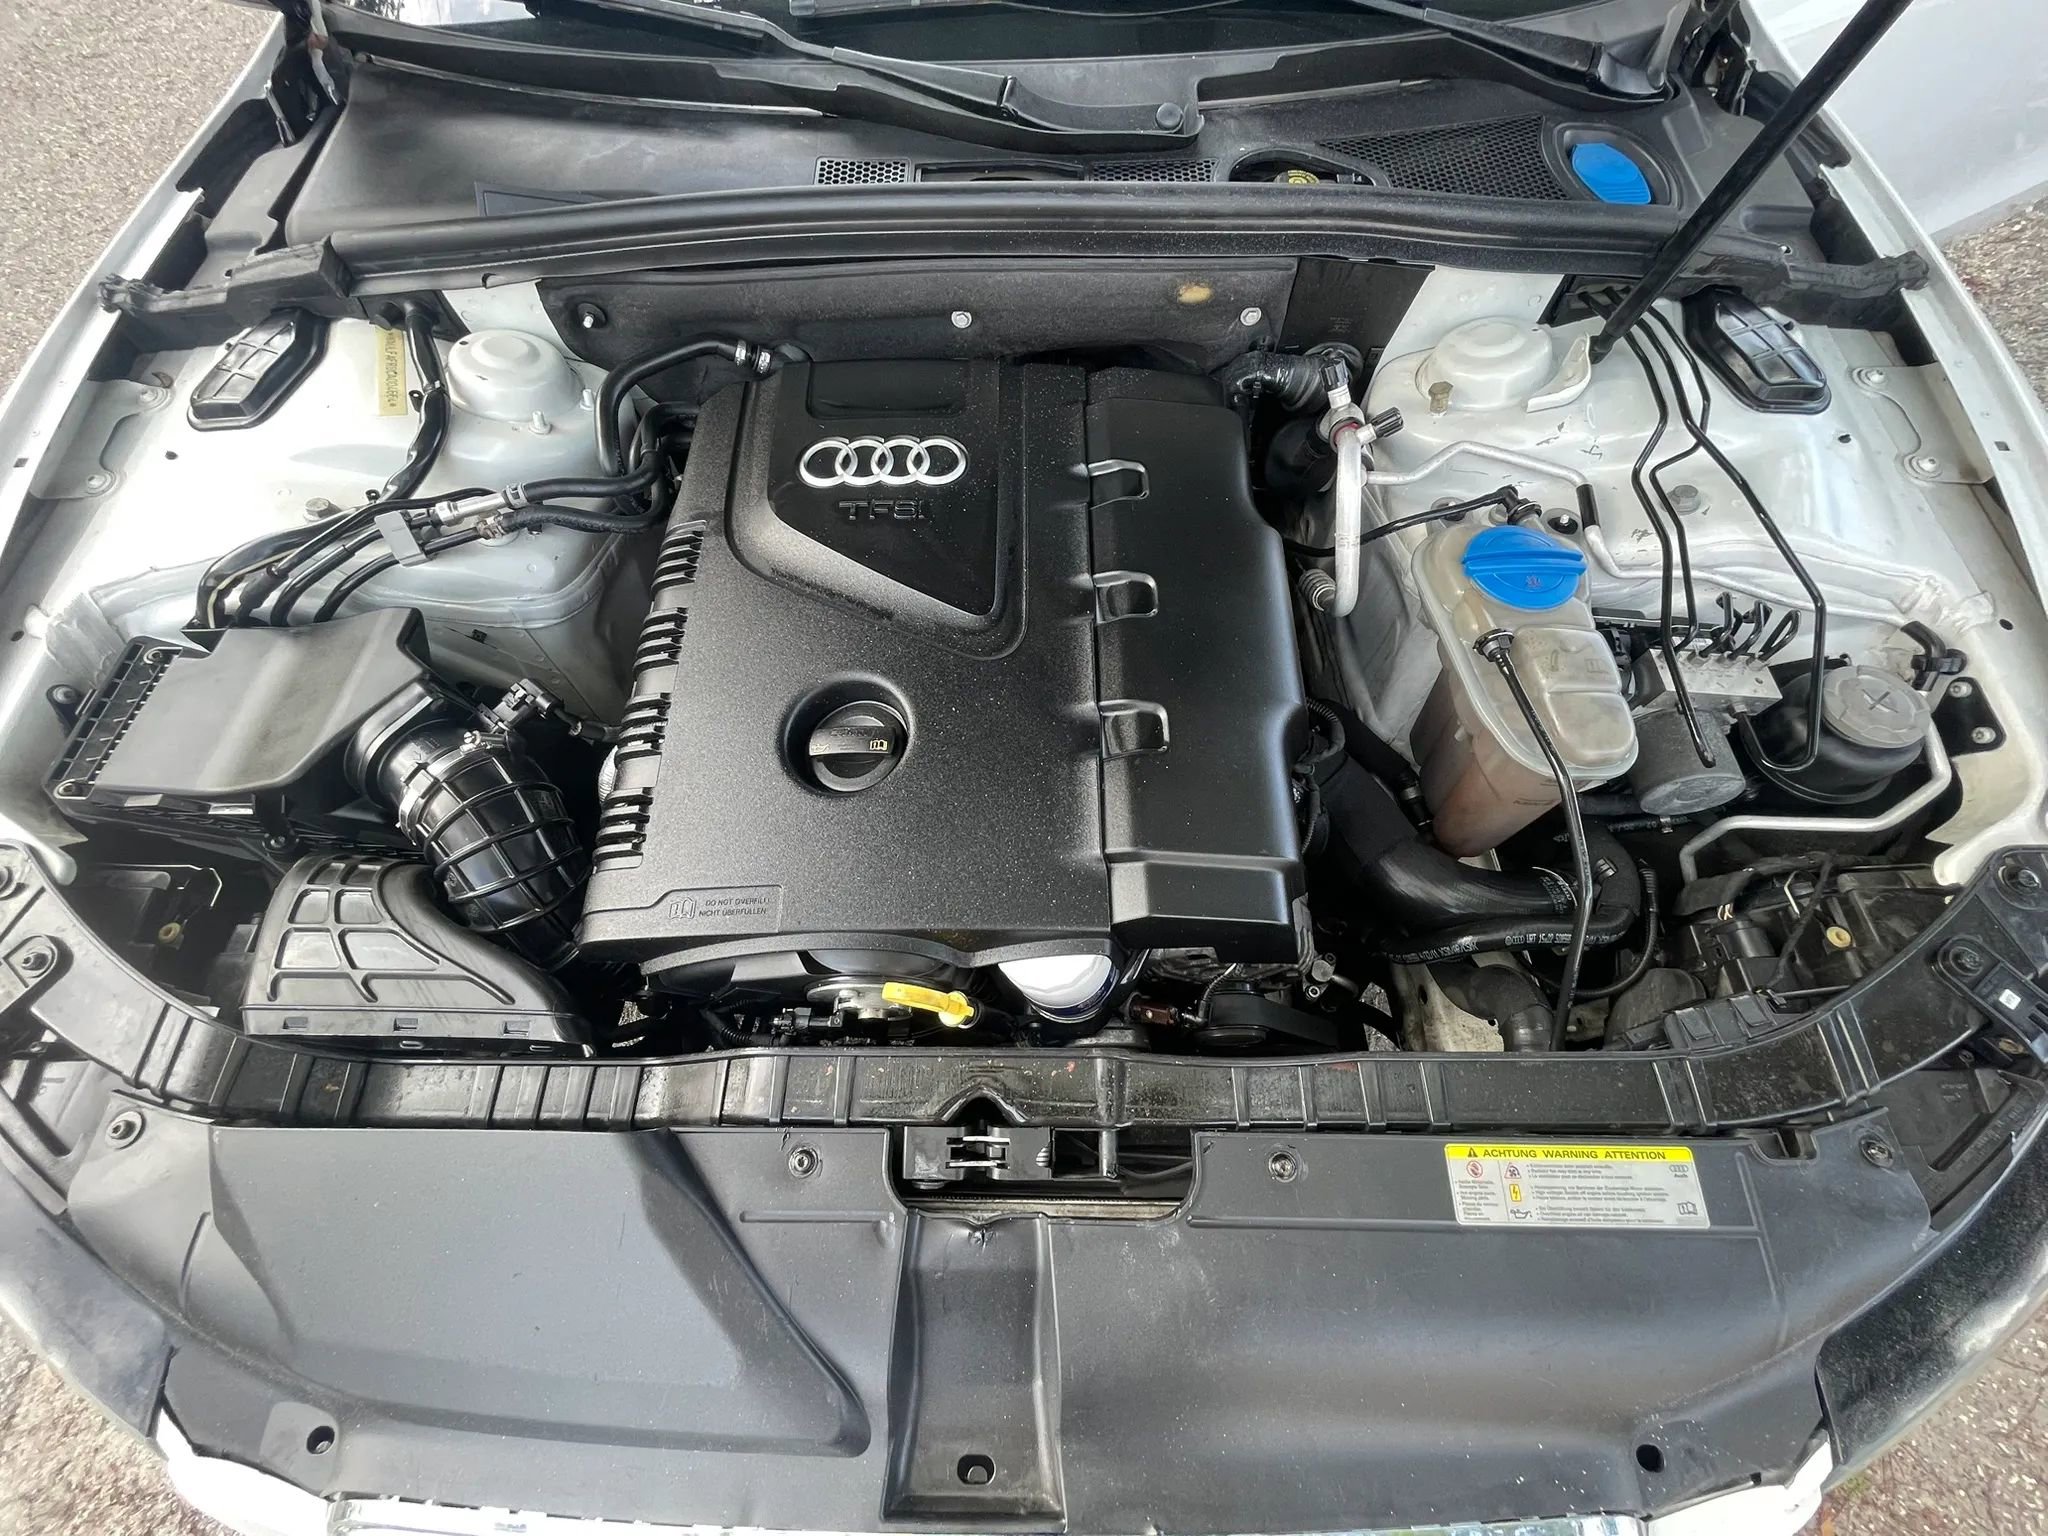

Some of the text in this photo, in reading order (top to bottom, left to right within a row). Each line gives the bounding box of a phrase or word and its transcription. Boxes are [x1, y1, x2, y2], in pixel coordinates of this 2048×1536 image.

[839, 500, 925, 520] TFSI
[705, 899, 717, 907] DO
[718, 898, 733, 906] NOT
[698, 909, 720, 917] NICHT
[1483, 1149, 1666, 1160] ACHTUNG WARNING ATTENTION
